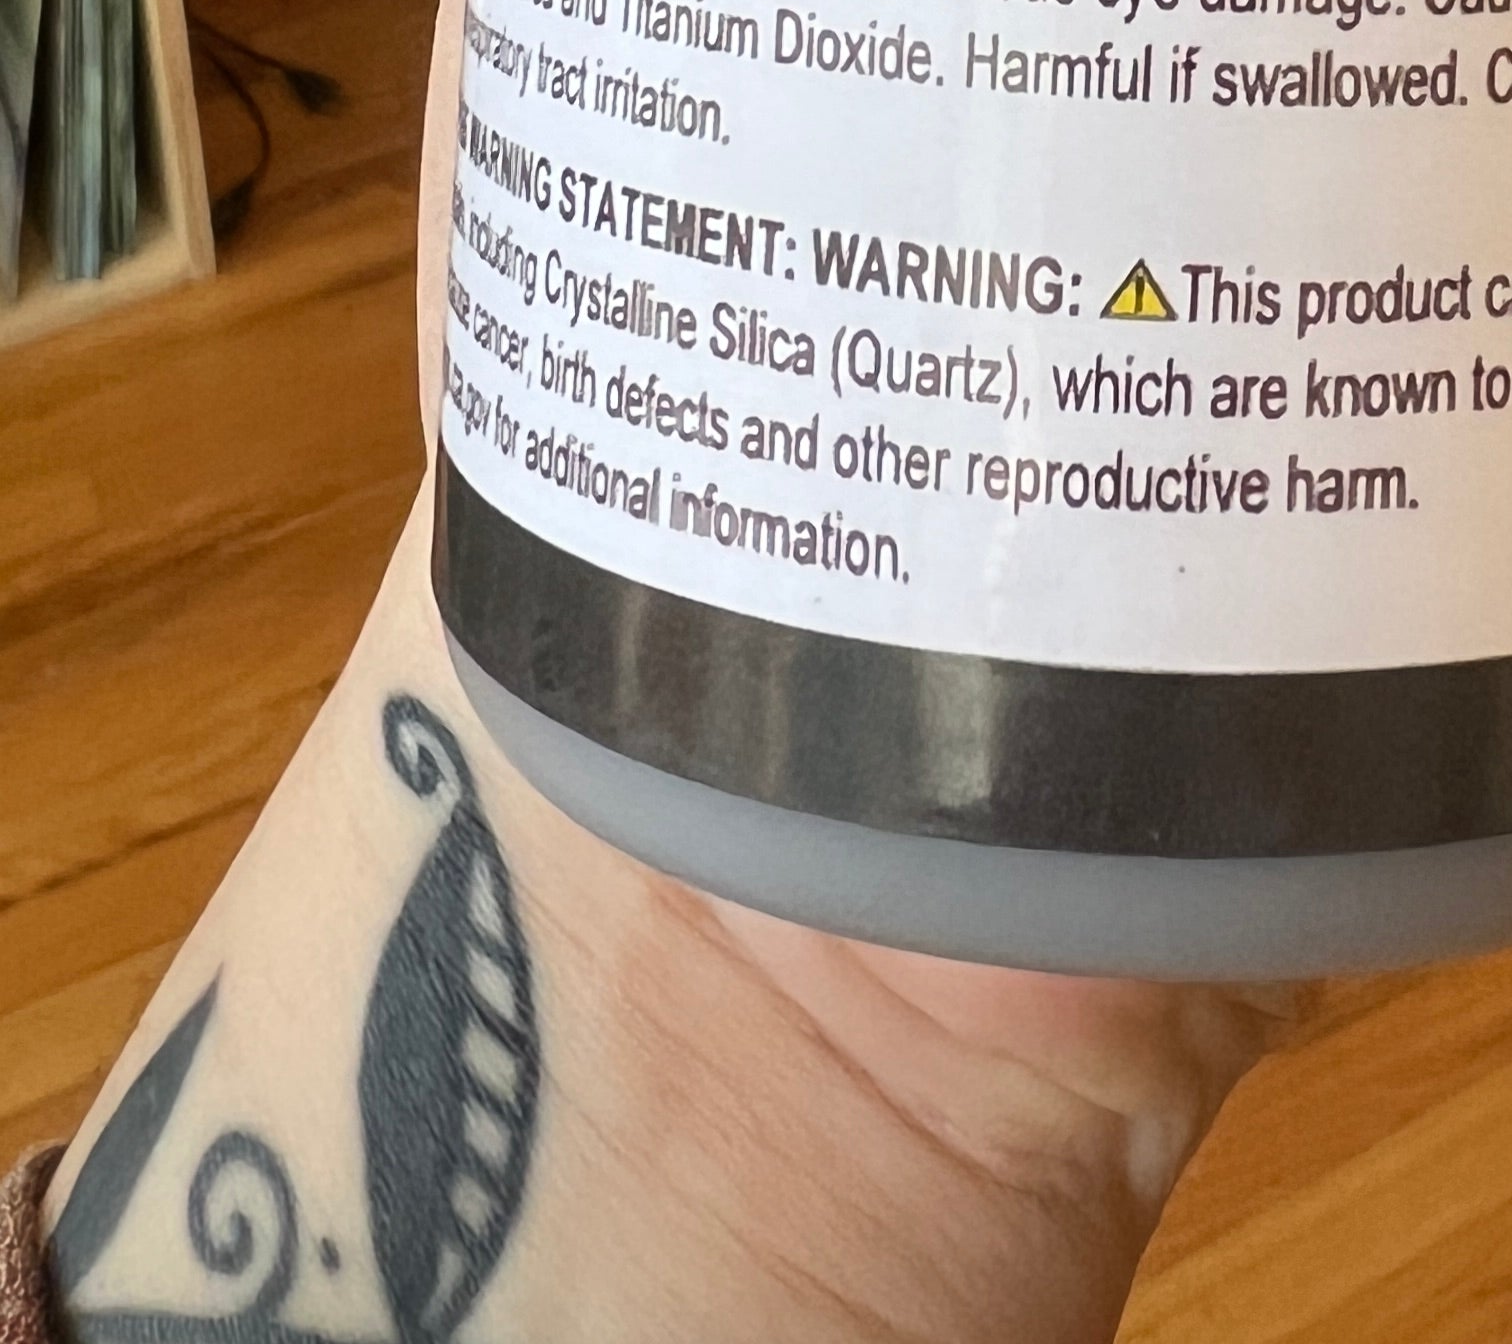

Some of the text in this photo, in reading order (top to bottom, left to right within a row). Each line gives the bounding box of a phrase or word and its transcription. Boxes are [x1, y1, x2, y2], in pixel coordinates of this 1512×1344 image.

[538, 41, 587, 110] tract
[594, 58, 730, 145] irritation.
[774, 8, 944, 86] Dioxide.
[966, 31, 1152, 103] Harmful
[1171, 44, 1201, 103] if
[1213, 49, 1468, 107] swallowed.
[545, 249, 697, 349] Crystalline
[710, 302, 815, 376] Silica
[831, 325, 1031, 421] (Quartz),
[1053, 353, 1192, 417] which
[1211, 373, 1287, 419] are
[1305, 358, 1456, 418] known
[1473, 354, 1511, 411] to
[559, 166, 796, 280] STATEMENT:
[812, 227, 1082, 317] WARNING:
[1181, 263, 1281, 325] This
[1297, 264, 1472, 340] product
[473, 303, 532, 389] cancer,
[541, 333, 596, 408] birth
[605, 364, 729, 450] defects
[740, 412, 819, 471] and
[833, 423, 951, 492] other
[966, 449, 1269, 516] reproductive
[1287, 454, 1419, 513] harm.
[494, 395, 521, 459] for
[525, 426, 660, 526] additional
[669, 472, 909, 585] information.
